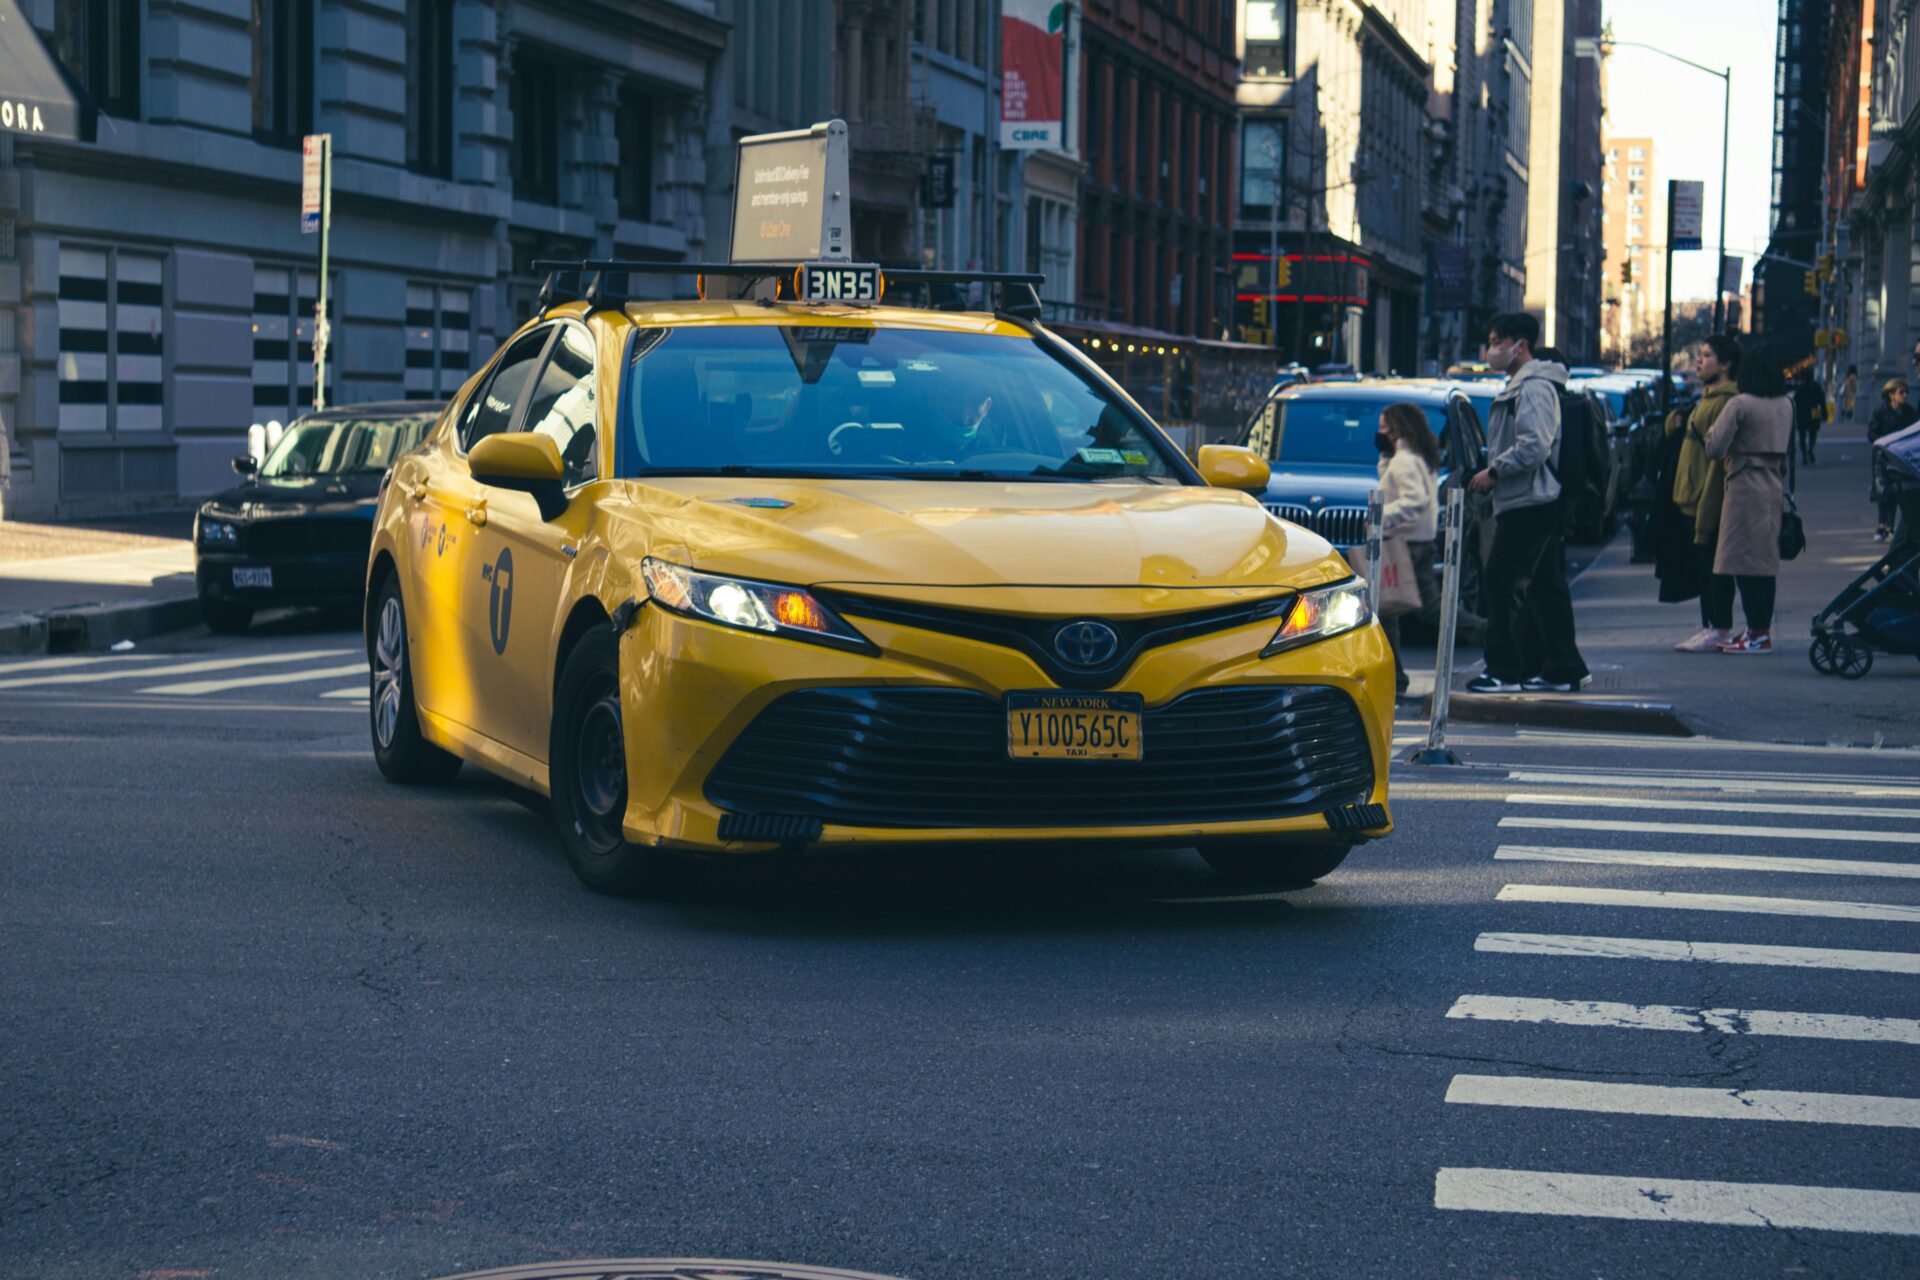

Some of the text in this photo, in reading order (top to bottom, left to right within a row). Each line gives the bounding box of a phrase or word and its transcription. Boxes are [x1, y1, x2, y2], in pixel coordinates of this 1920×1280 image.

[811, 271, 873, 300] 3N35
[1041, 697, 1110, 709] NEW YORK
[1020, 712, 1130, 748] Y100565C
